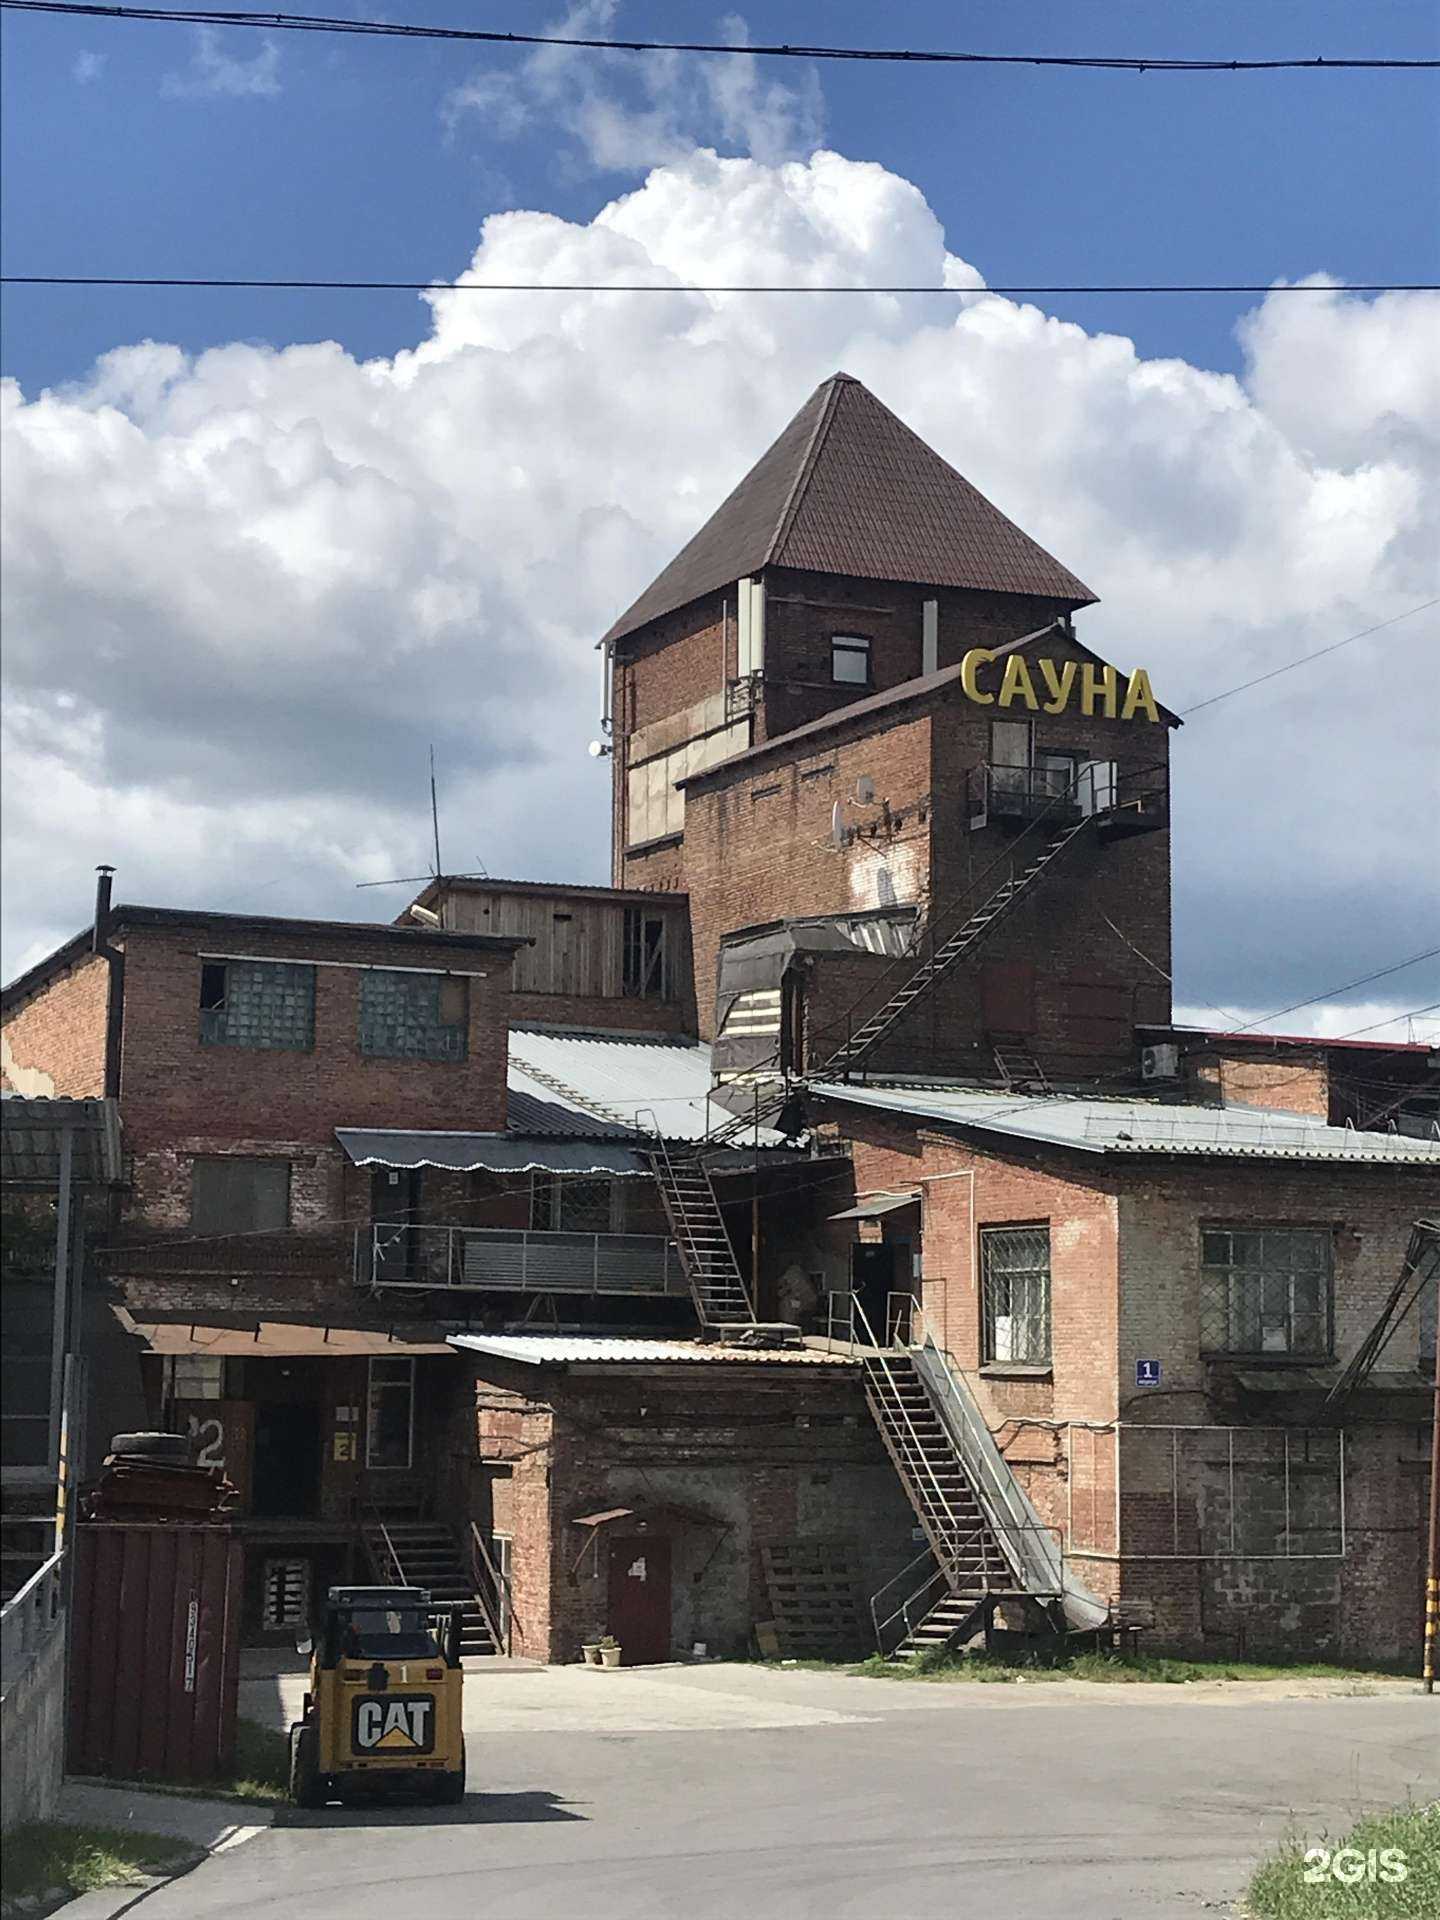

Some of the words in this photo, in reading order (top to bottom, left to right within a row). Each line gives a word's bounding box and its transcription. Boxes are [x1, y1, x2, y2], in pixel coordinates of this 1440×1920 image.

[961, 648, 1160, 723] САУНА
[1143, 1362, 1153, 1378] 1
[400, 1665, 408, 1684] 1
[358, 1702, 430, 1747] CAT
